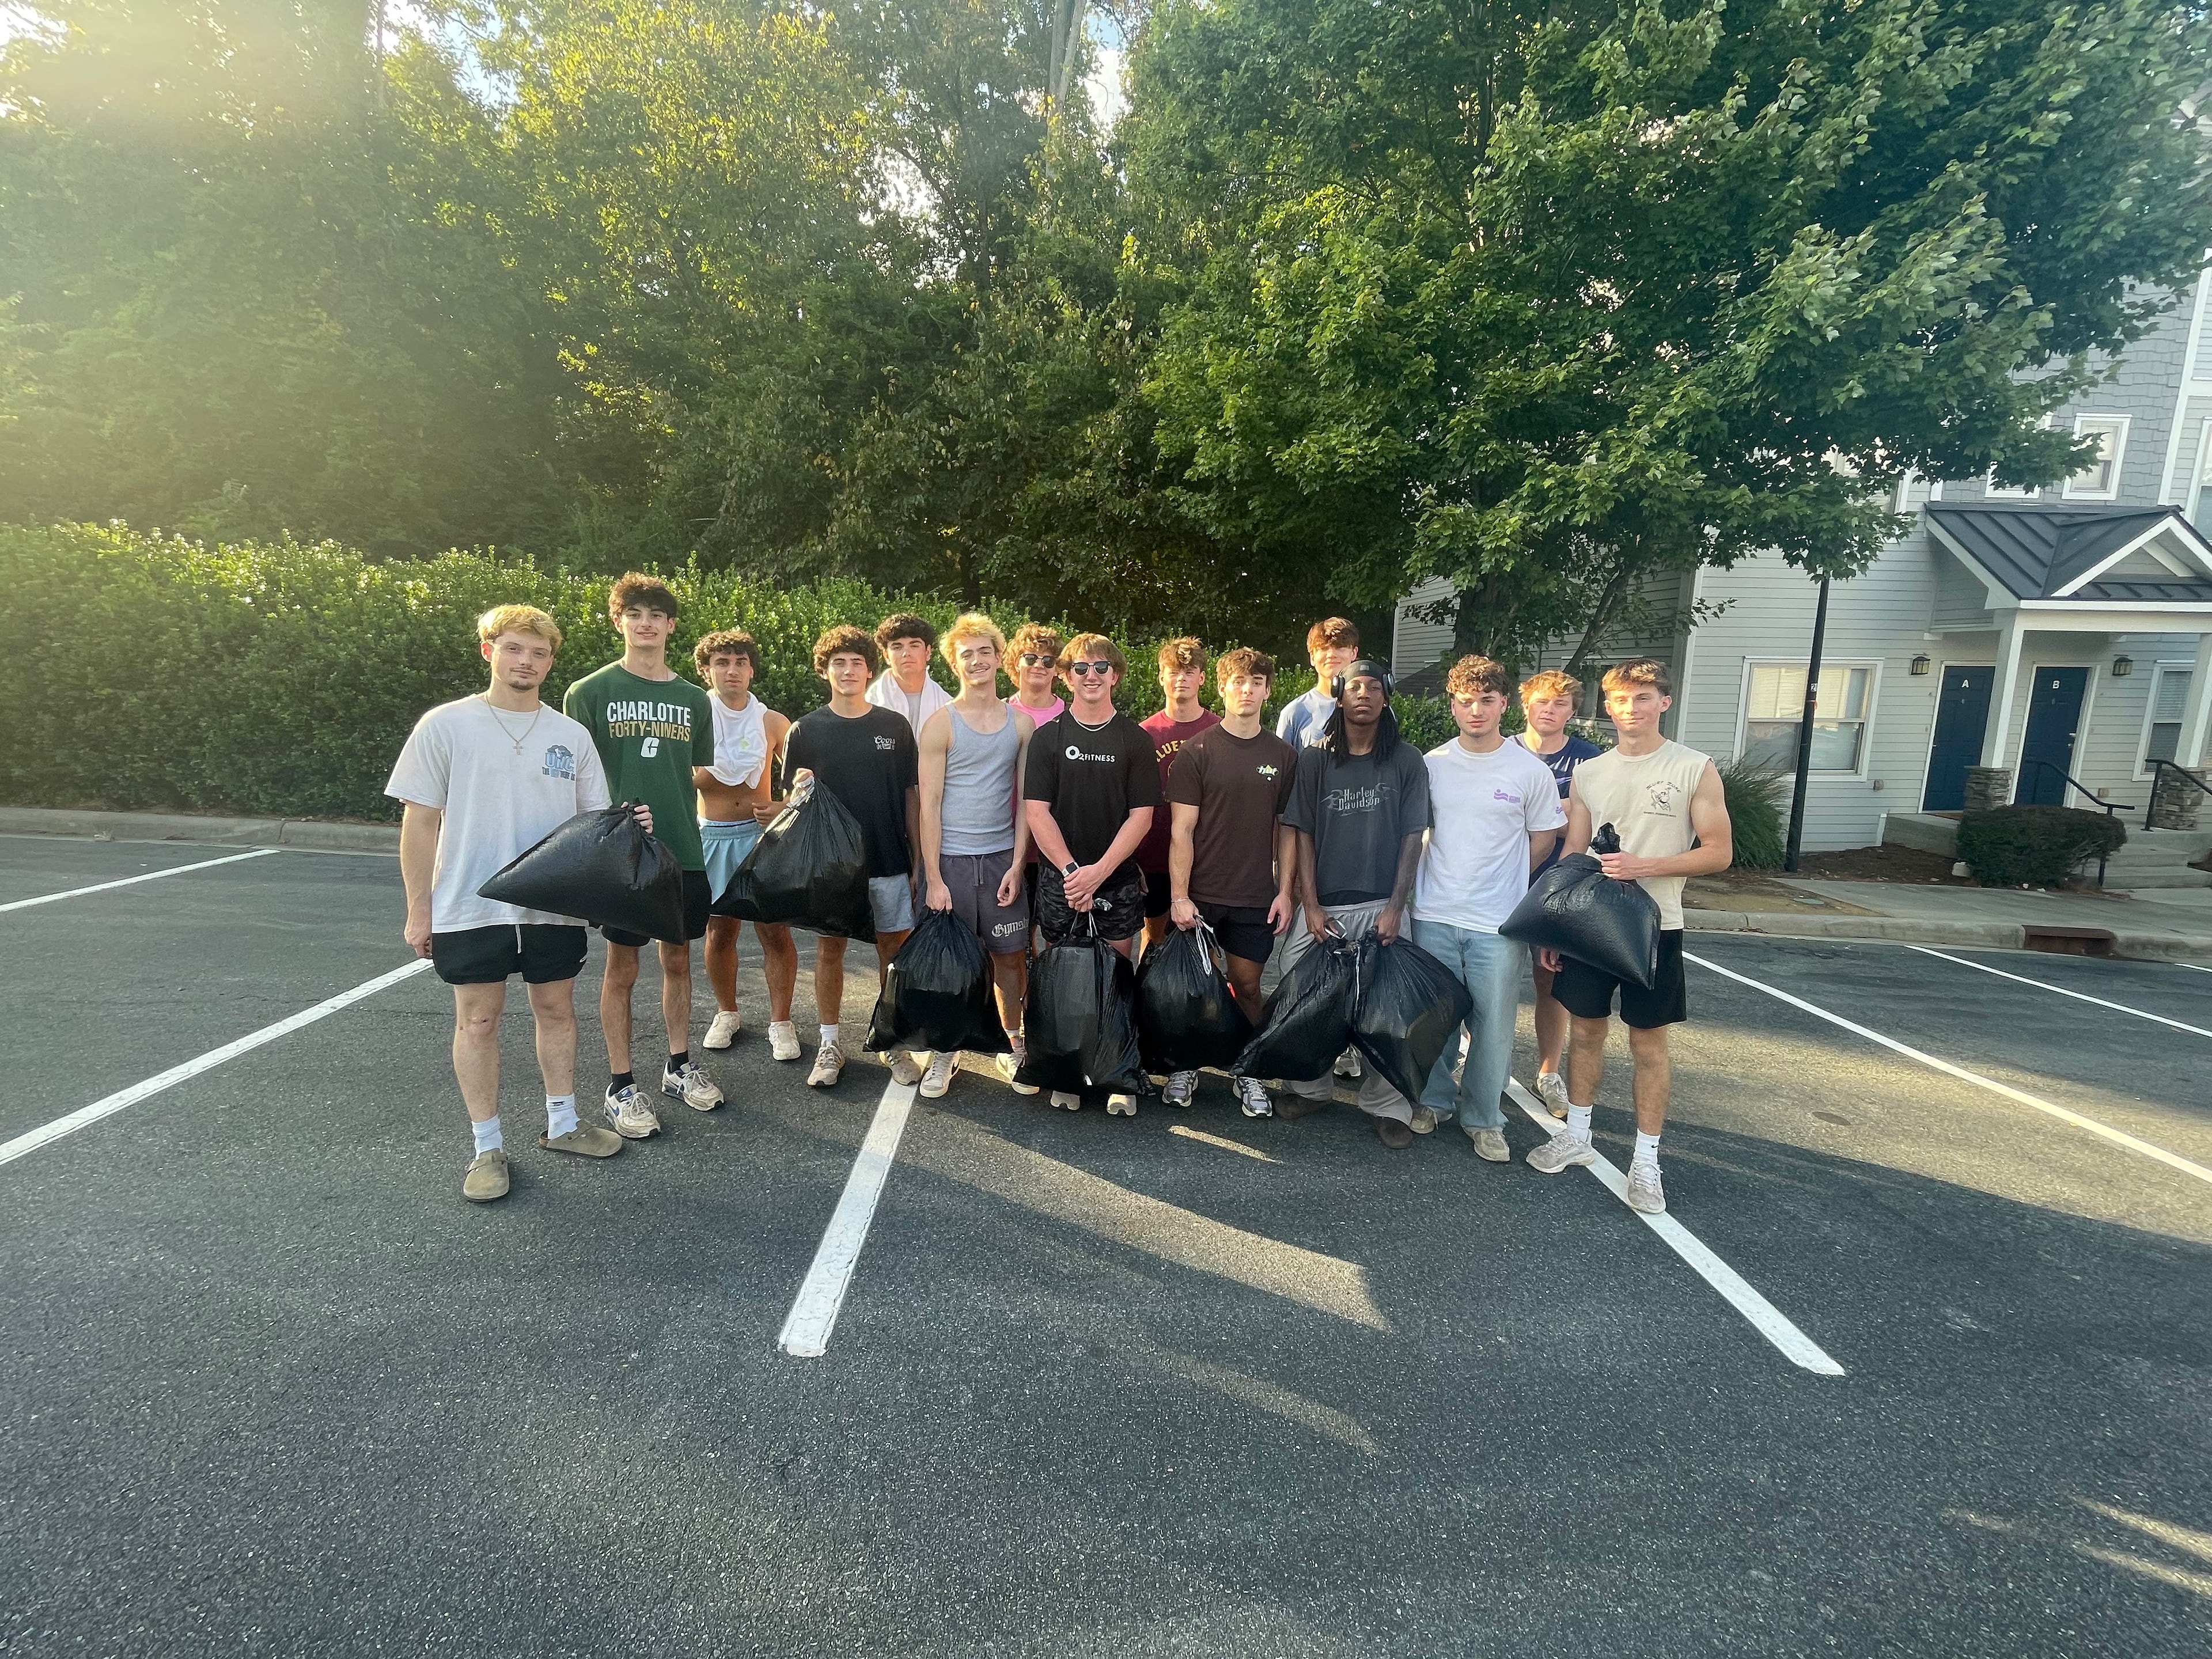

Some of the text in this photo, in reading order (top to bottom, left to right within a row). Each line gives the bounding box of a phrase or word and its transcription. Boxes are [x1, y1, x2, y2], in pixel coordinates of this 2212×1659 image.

[1961, 679, 1970, 688] A
[2052, 680, 2061, 689] B
[607, 700, 691, 727] CHARLOTTE
[608, 721, 691, 742] FORTY-NINERS
[545, 753, 574, 772] UNC
[1344, 786, 1375, 802] Harley
[1338, 797, 1380, 811] Davidson
